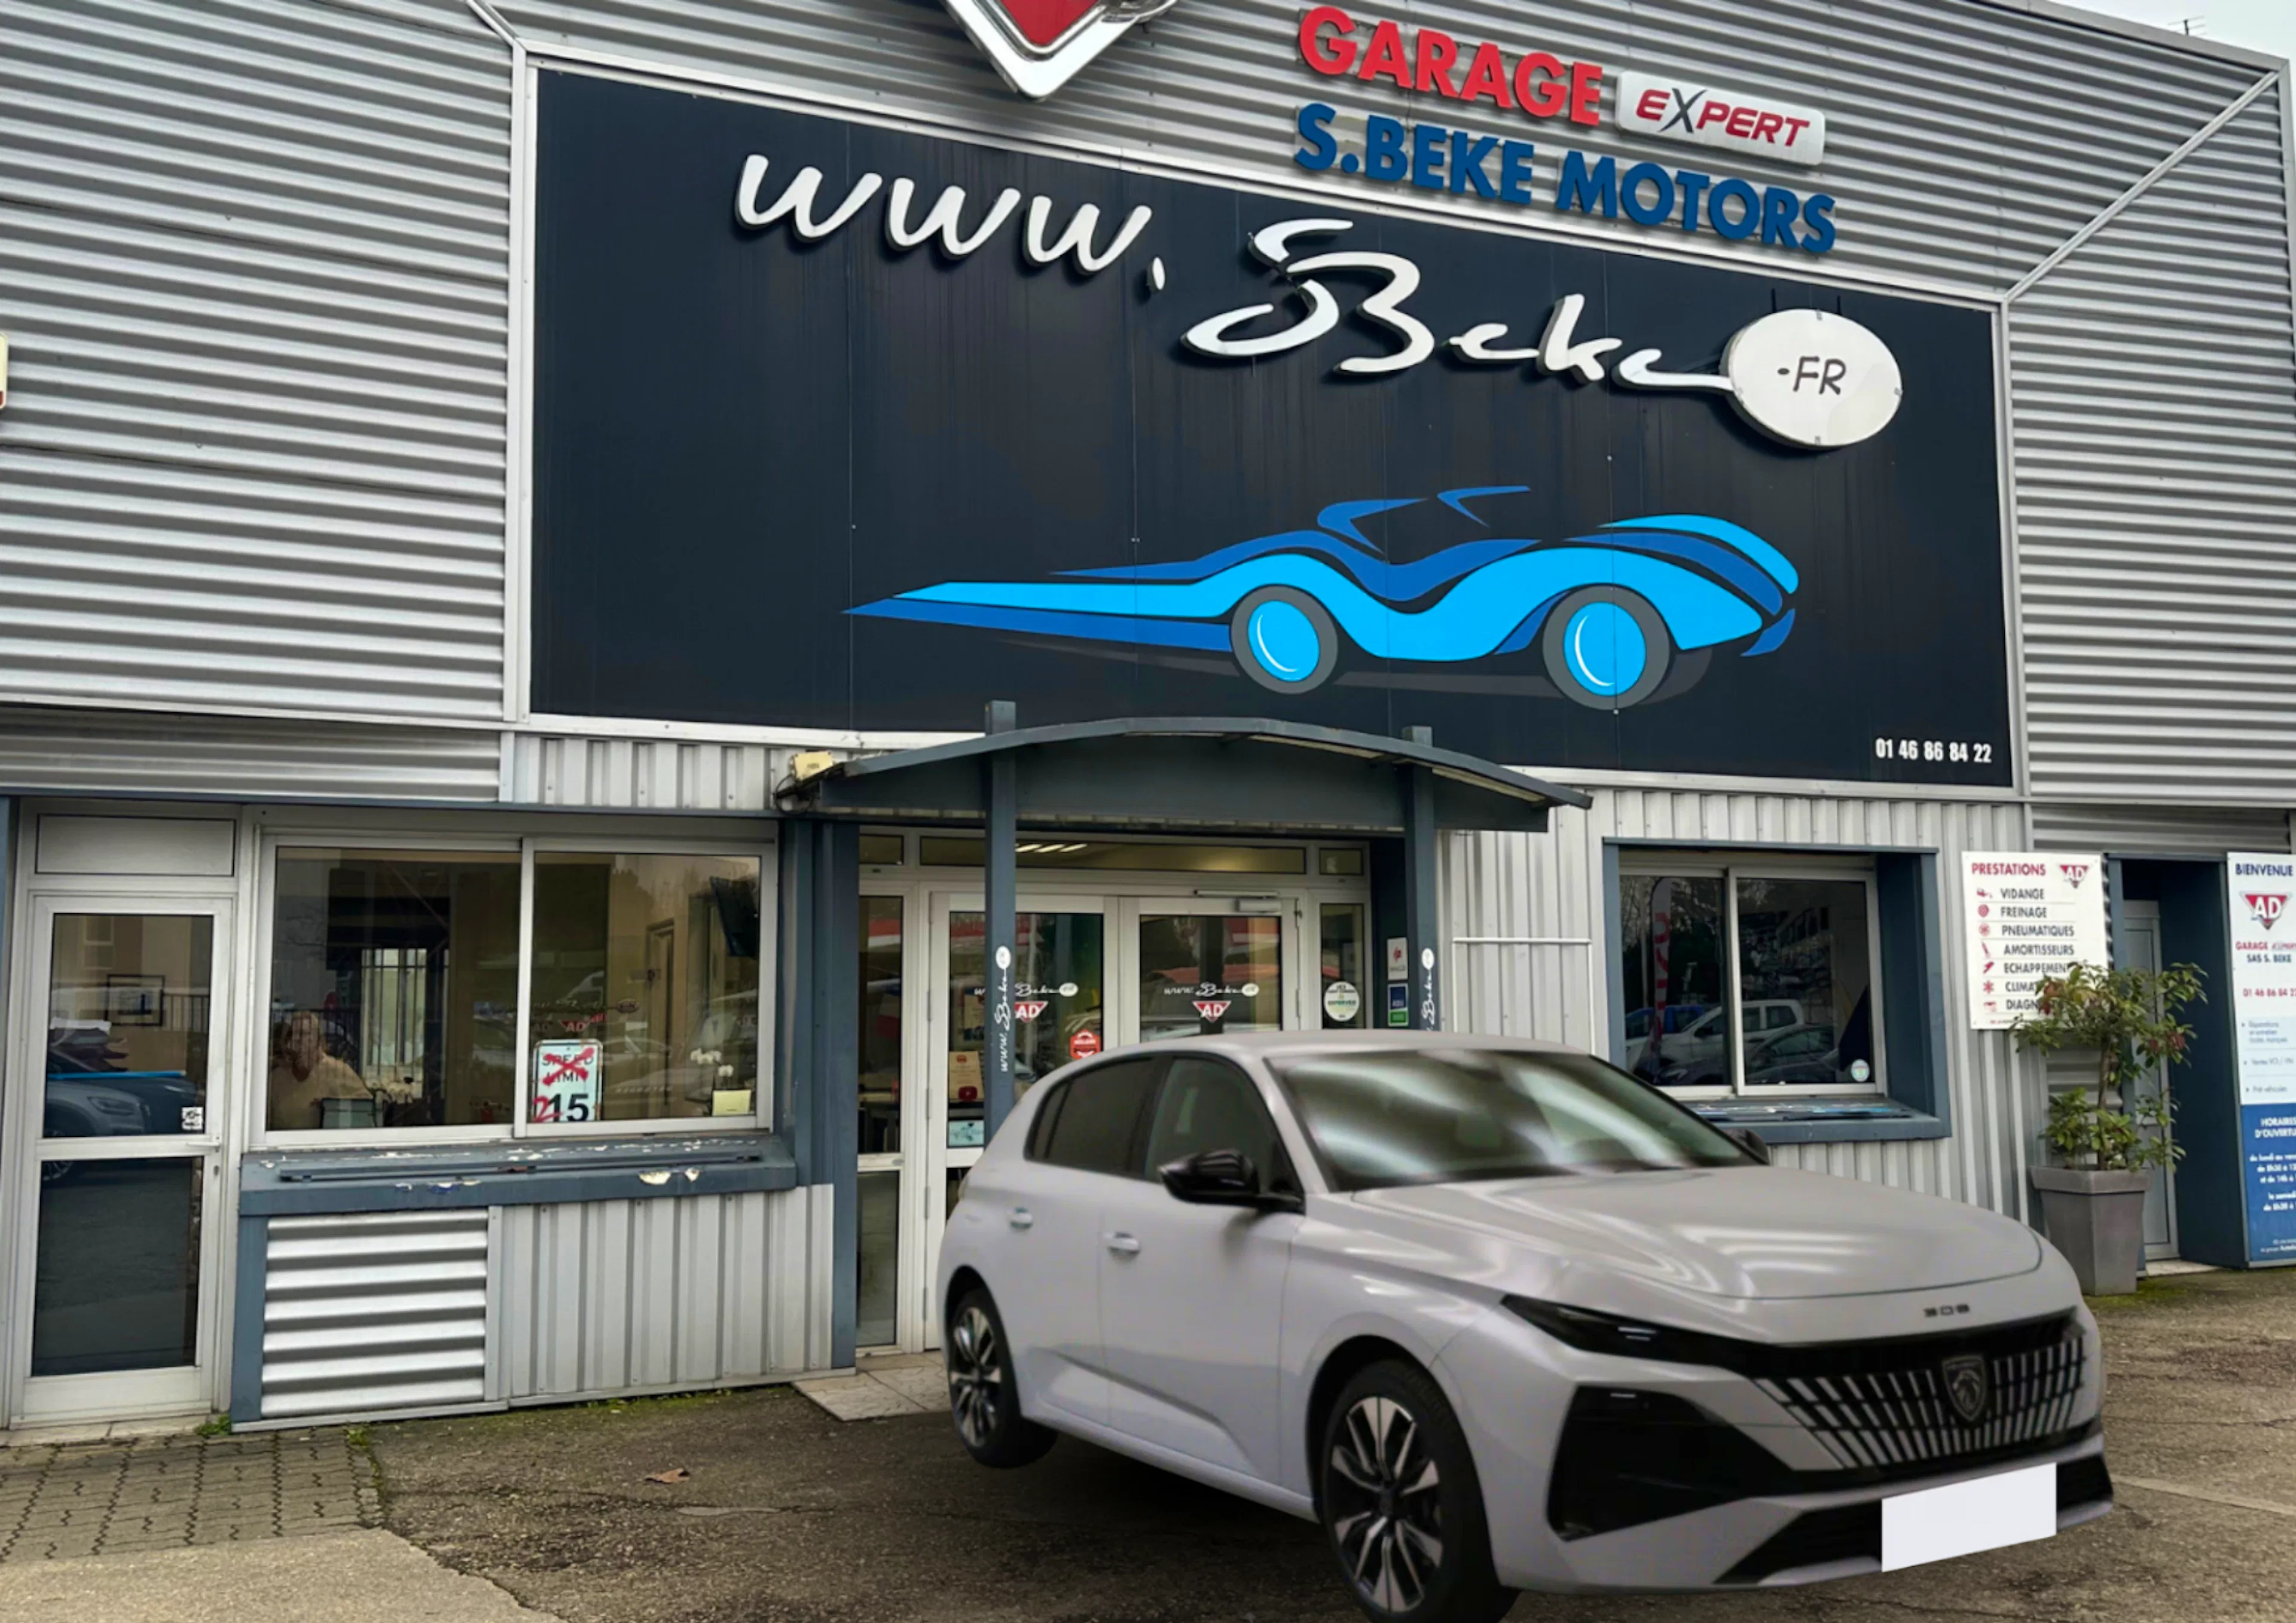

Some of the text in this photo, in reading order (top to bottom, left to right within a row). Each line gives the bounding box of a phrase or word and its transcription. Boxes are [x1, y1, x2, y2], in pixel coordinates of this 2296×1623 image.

[1299, 5, 1810, 148] GARAGE EXPERT
[1294, 103, 1836, 254] S.BEKE MOTORS
[735, 154, 1165, 291] www.
[1875, 737, 1992, 764] 01 46 86 84 22
[1971, 862, 2047, 876] PRESTATIONS
[2235, 863, 2294, 877] BIENVENUE
[2000, 888, 2044, 900] VIDANGE
[2000, 906, 2047, 918] FREINAGE
[2255, 896, 2282, 919] AD
[2002, 925, 2075, 936] PNEUMATIQUES
[2004, 944, 2075, 955] AMORTISSEURS
[2235, 941, 2268, 951] GARAGE
[1015, 1005, 1039, 1018] AD
[1201, 1003, 1223, 1018] AD
